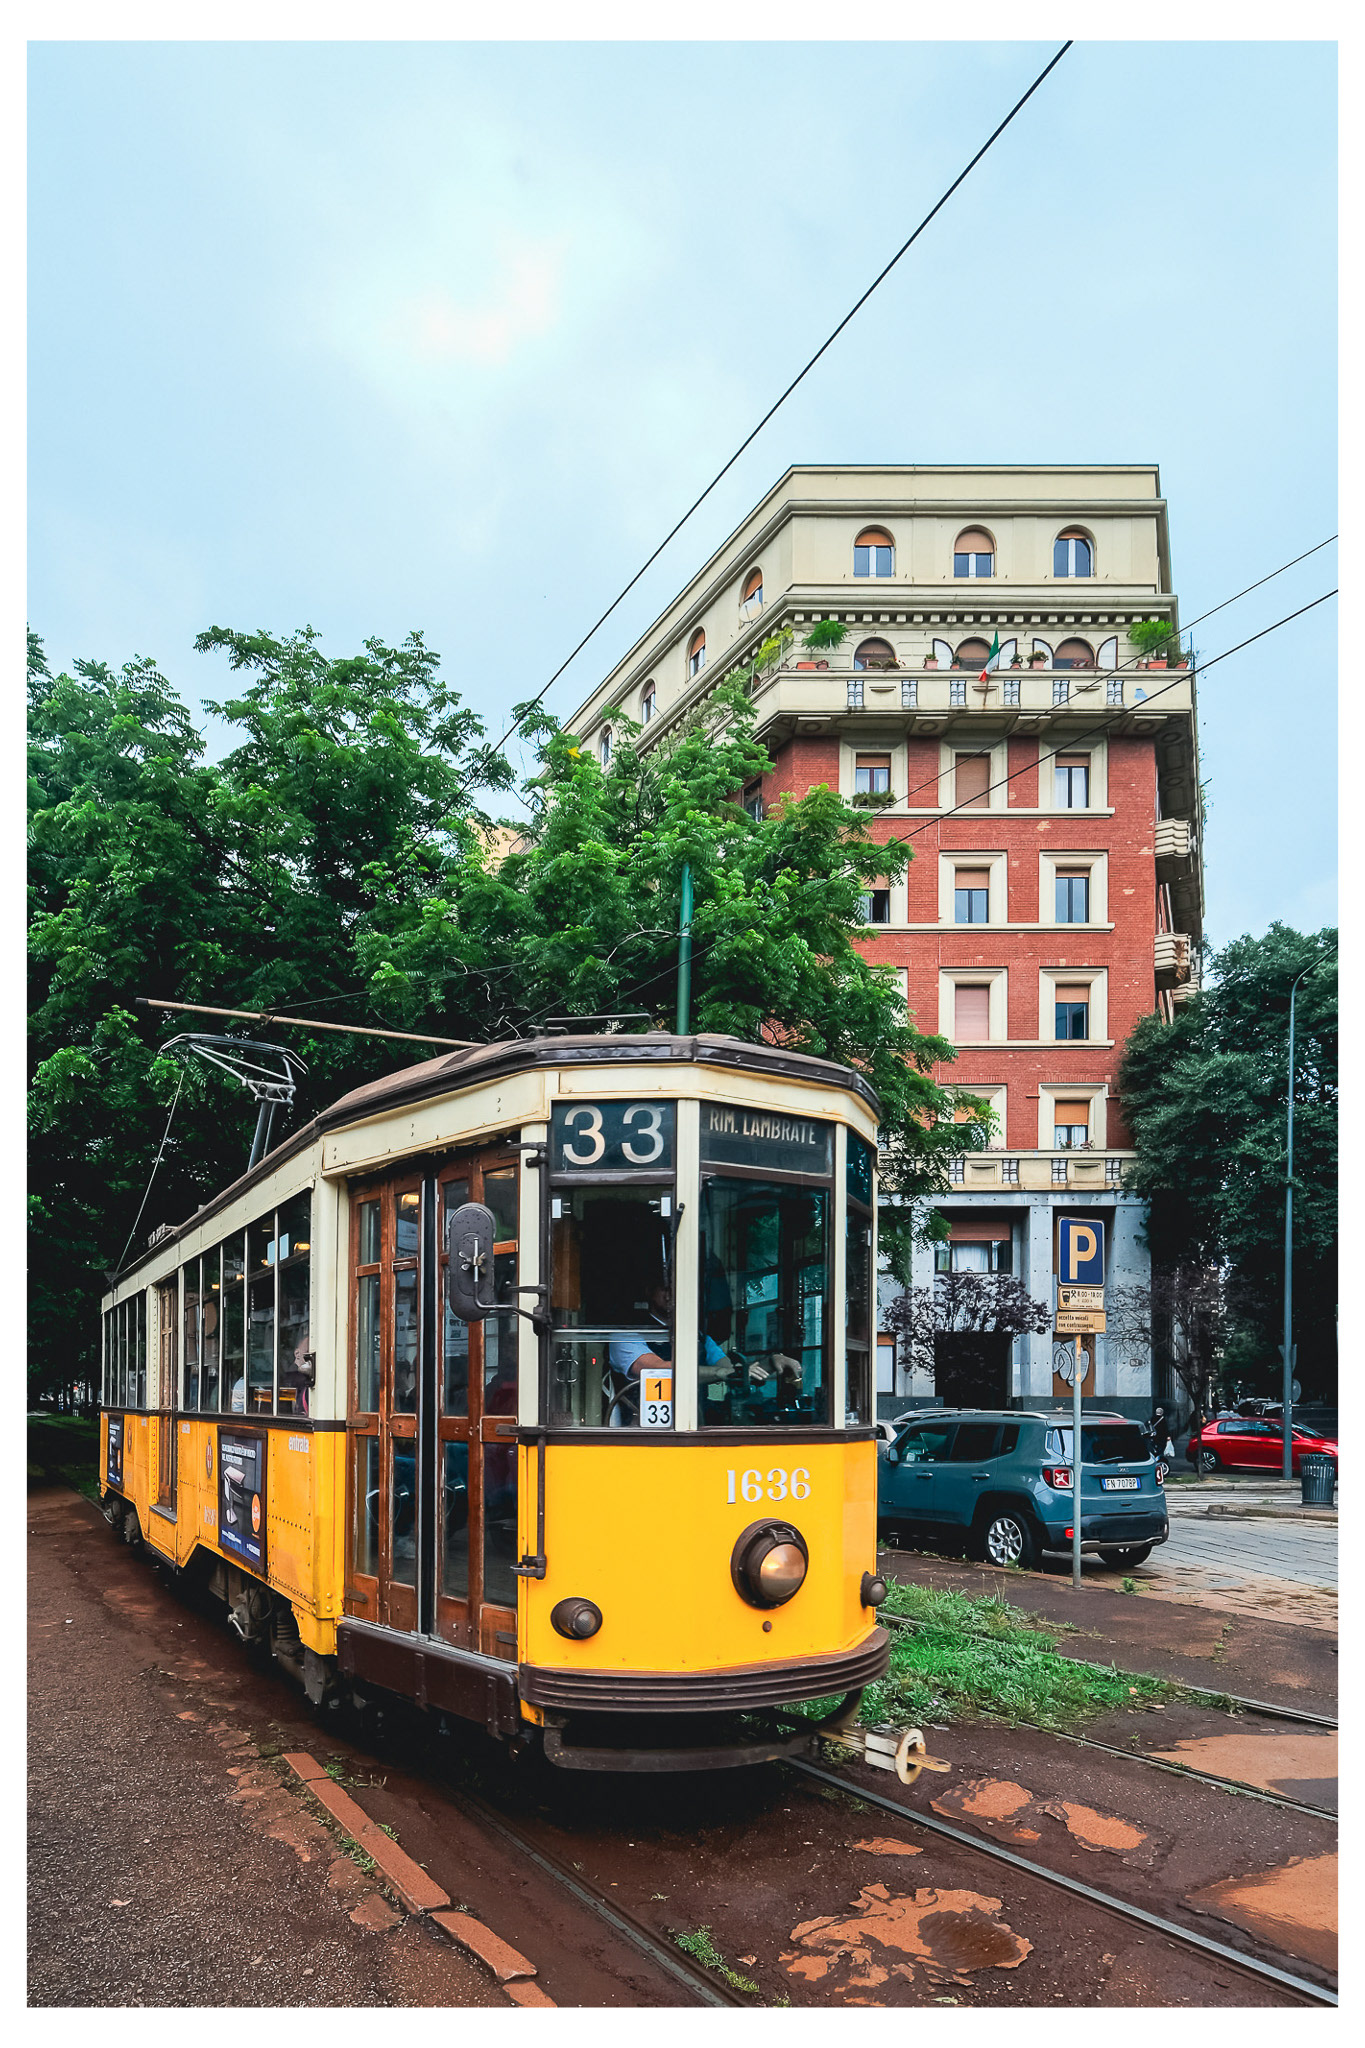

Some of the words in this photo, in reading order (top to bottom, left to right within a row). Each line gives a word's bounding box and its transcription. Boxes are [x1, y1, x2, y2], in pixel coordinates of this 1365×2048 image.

[562, 1103, 665, 1166] 33
[709, 1107, 739, 1135] RIM.
[743, 1114, 816, 1145] LAMBRATE
[1069, 1225, 1097, 1280] P
[654, 1380, 662, 1400] 1
[647, 1404, 670, 1424] 33
[726, 1467, 811, 1505] 1636
